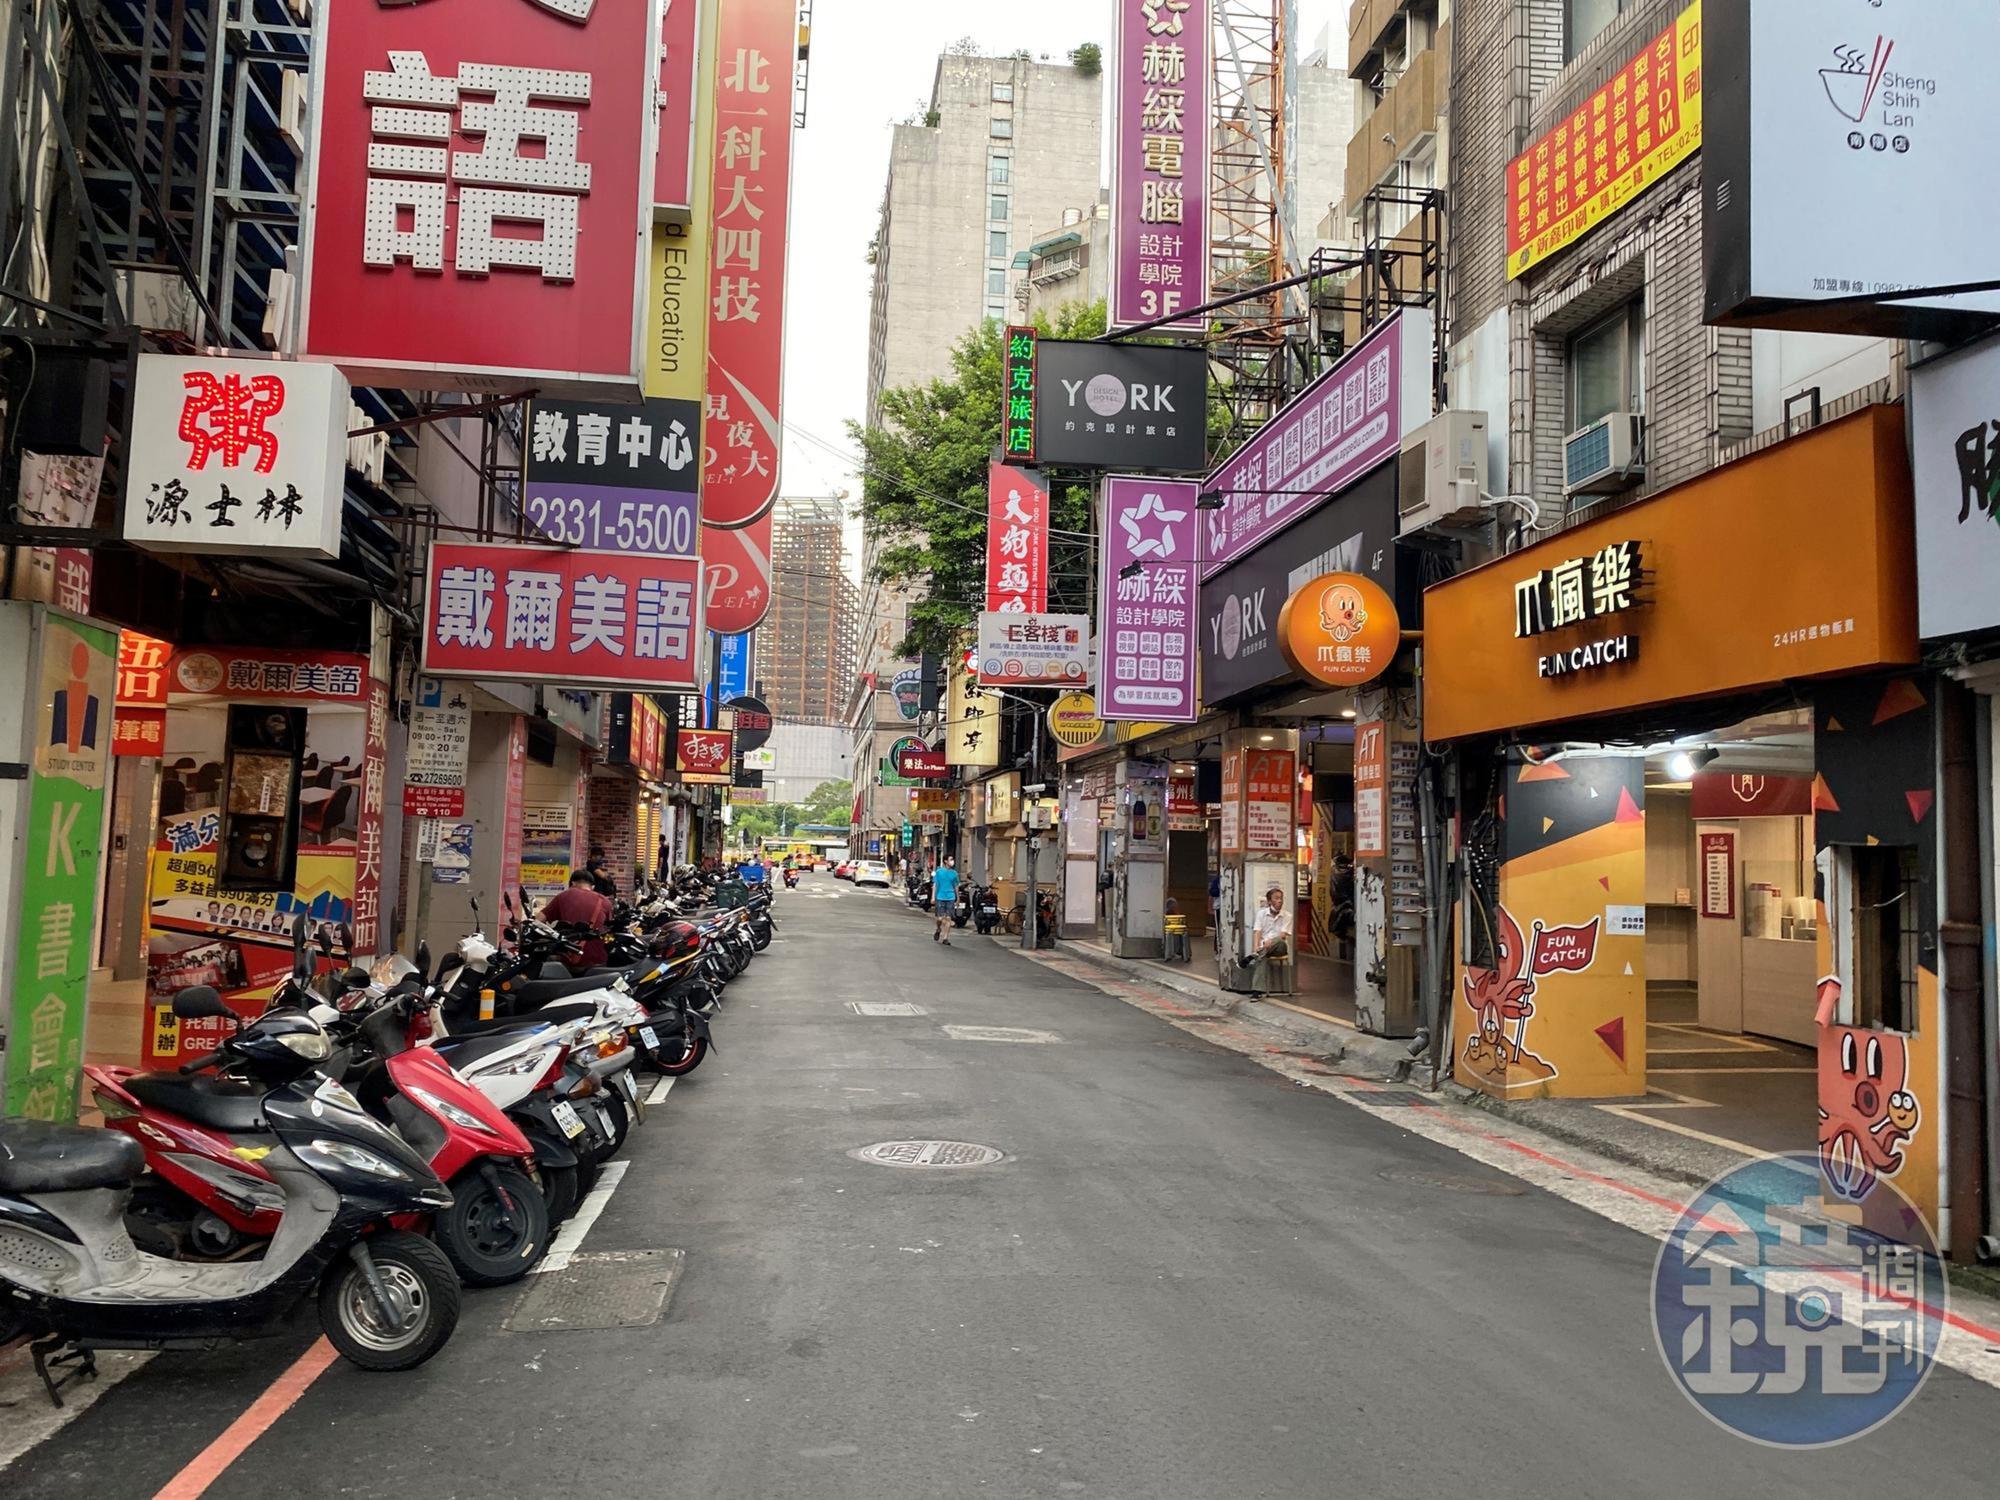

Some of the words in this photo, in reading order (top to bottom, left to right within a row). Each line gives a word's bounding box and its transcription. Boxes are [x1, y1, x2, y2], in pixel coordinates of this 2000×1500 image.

[1681, 21, 1700, 103] 印刷
[1655, 32, 1676, 139] 名片DM
[1882, 71, 1936, 95] Sheng
[1883, 91, 1920, 108] Shih
[1883, 110, 1914, 127] Lan
[1141, 41, 1186, 226] 赫綵電腦
[364, 51, 592, 283] 語
[713, 47, 771, 324] 北一科大四技
[1140, 233, 1184, 257] 設計
[1138, 264, 1184, 286] 學院
[1812, 278, 1864, 293] 加盟專線
[661, 247, 688, 373] Education
[1139, 289, 1182, 317] 3F
[1007, 335, 1034, 451] 約克旅店
[1061, 374, 1176, 417] YORK
[179, 371, 286, 474] 粥
[1065, 421, 1176, 437] 約克設計旅店
[533, 410, 694, 472] 教育中心
[529, 496, 692, 554] 2331-5500
[1371, 549, 1384, 573] 4F
[1514, 541, 1633, 638] 爪瘋樂
[435, 565, 694, 660] 戴爾美語
[1115, 607, 1187, 628] 設計學院
[1211, 587, 1267, 655] YORK
[1317, 646, 1371, 662] 爪瘋樂
[1538, 653, 1569, 678] FUN
[1570, 635, 1628, 671] CATCH
[226, 659, 363, 695] 戴爾美語
[437, 744, 449, 752] 20
[684, 734, 725, 763] すき家
[1359, 727, 1380, 763] AT
[1224, 755, 1238, 781] AT
[1250, 755, 1292, 780] AT
[356, 687, 390, 949] 戴爾美語
[434, 808, 450, 816] 110
[1539, 948, 1588, 964] CATCH
[1546, 936, 1577, 949] FUN
[183, 1037, 216, 1051] GRE
